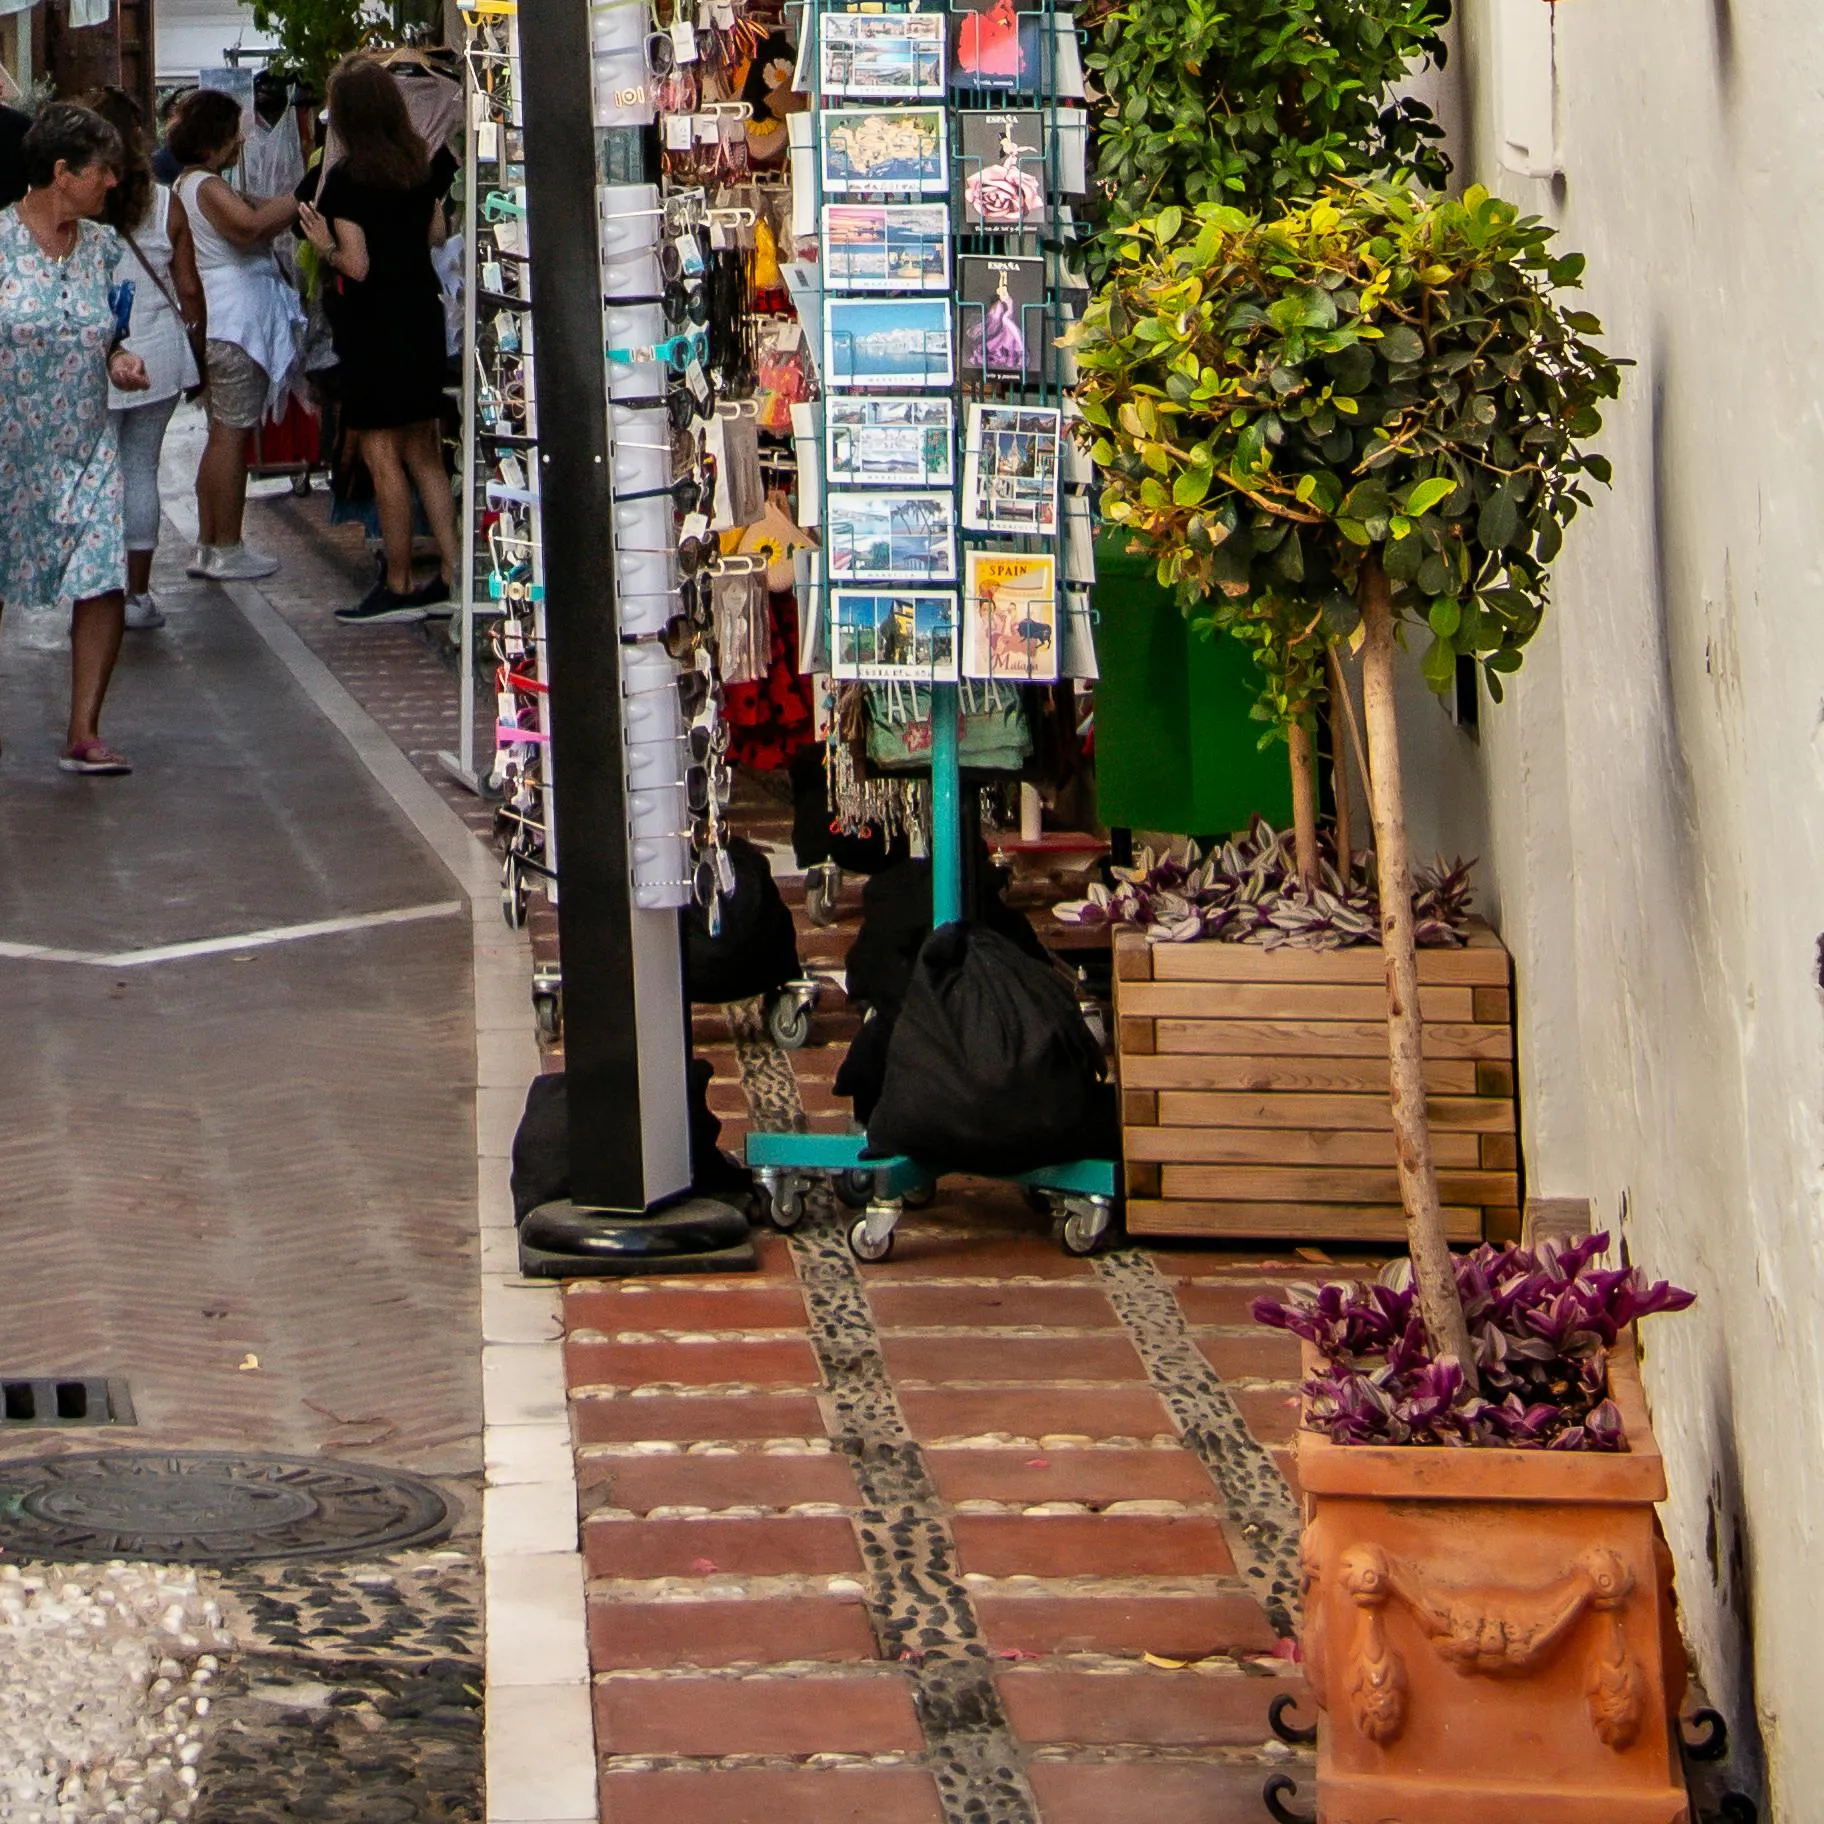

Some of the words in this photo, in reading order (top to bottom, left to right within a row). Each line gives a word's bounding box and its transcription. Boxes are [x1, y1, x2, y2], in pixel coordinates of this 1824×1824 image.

[985, 114, 1019, 124] ESPAÑA
[987, 261, 1021, 271] ESPAÑA
[989, 564, 1028, 577] SPAIN
